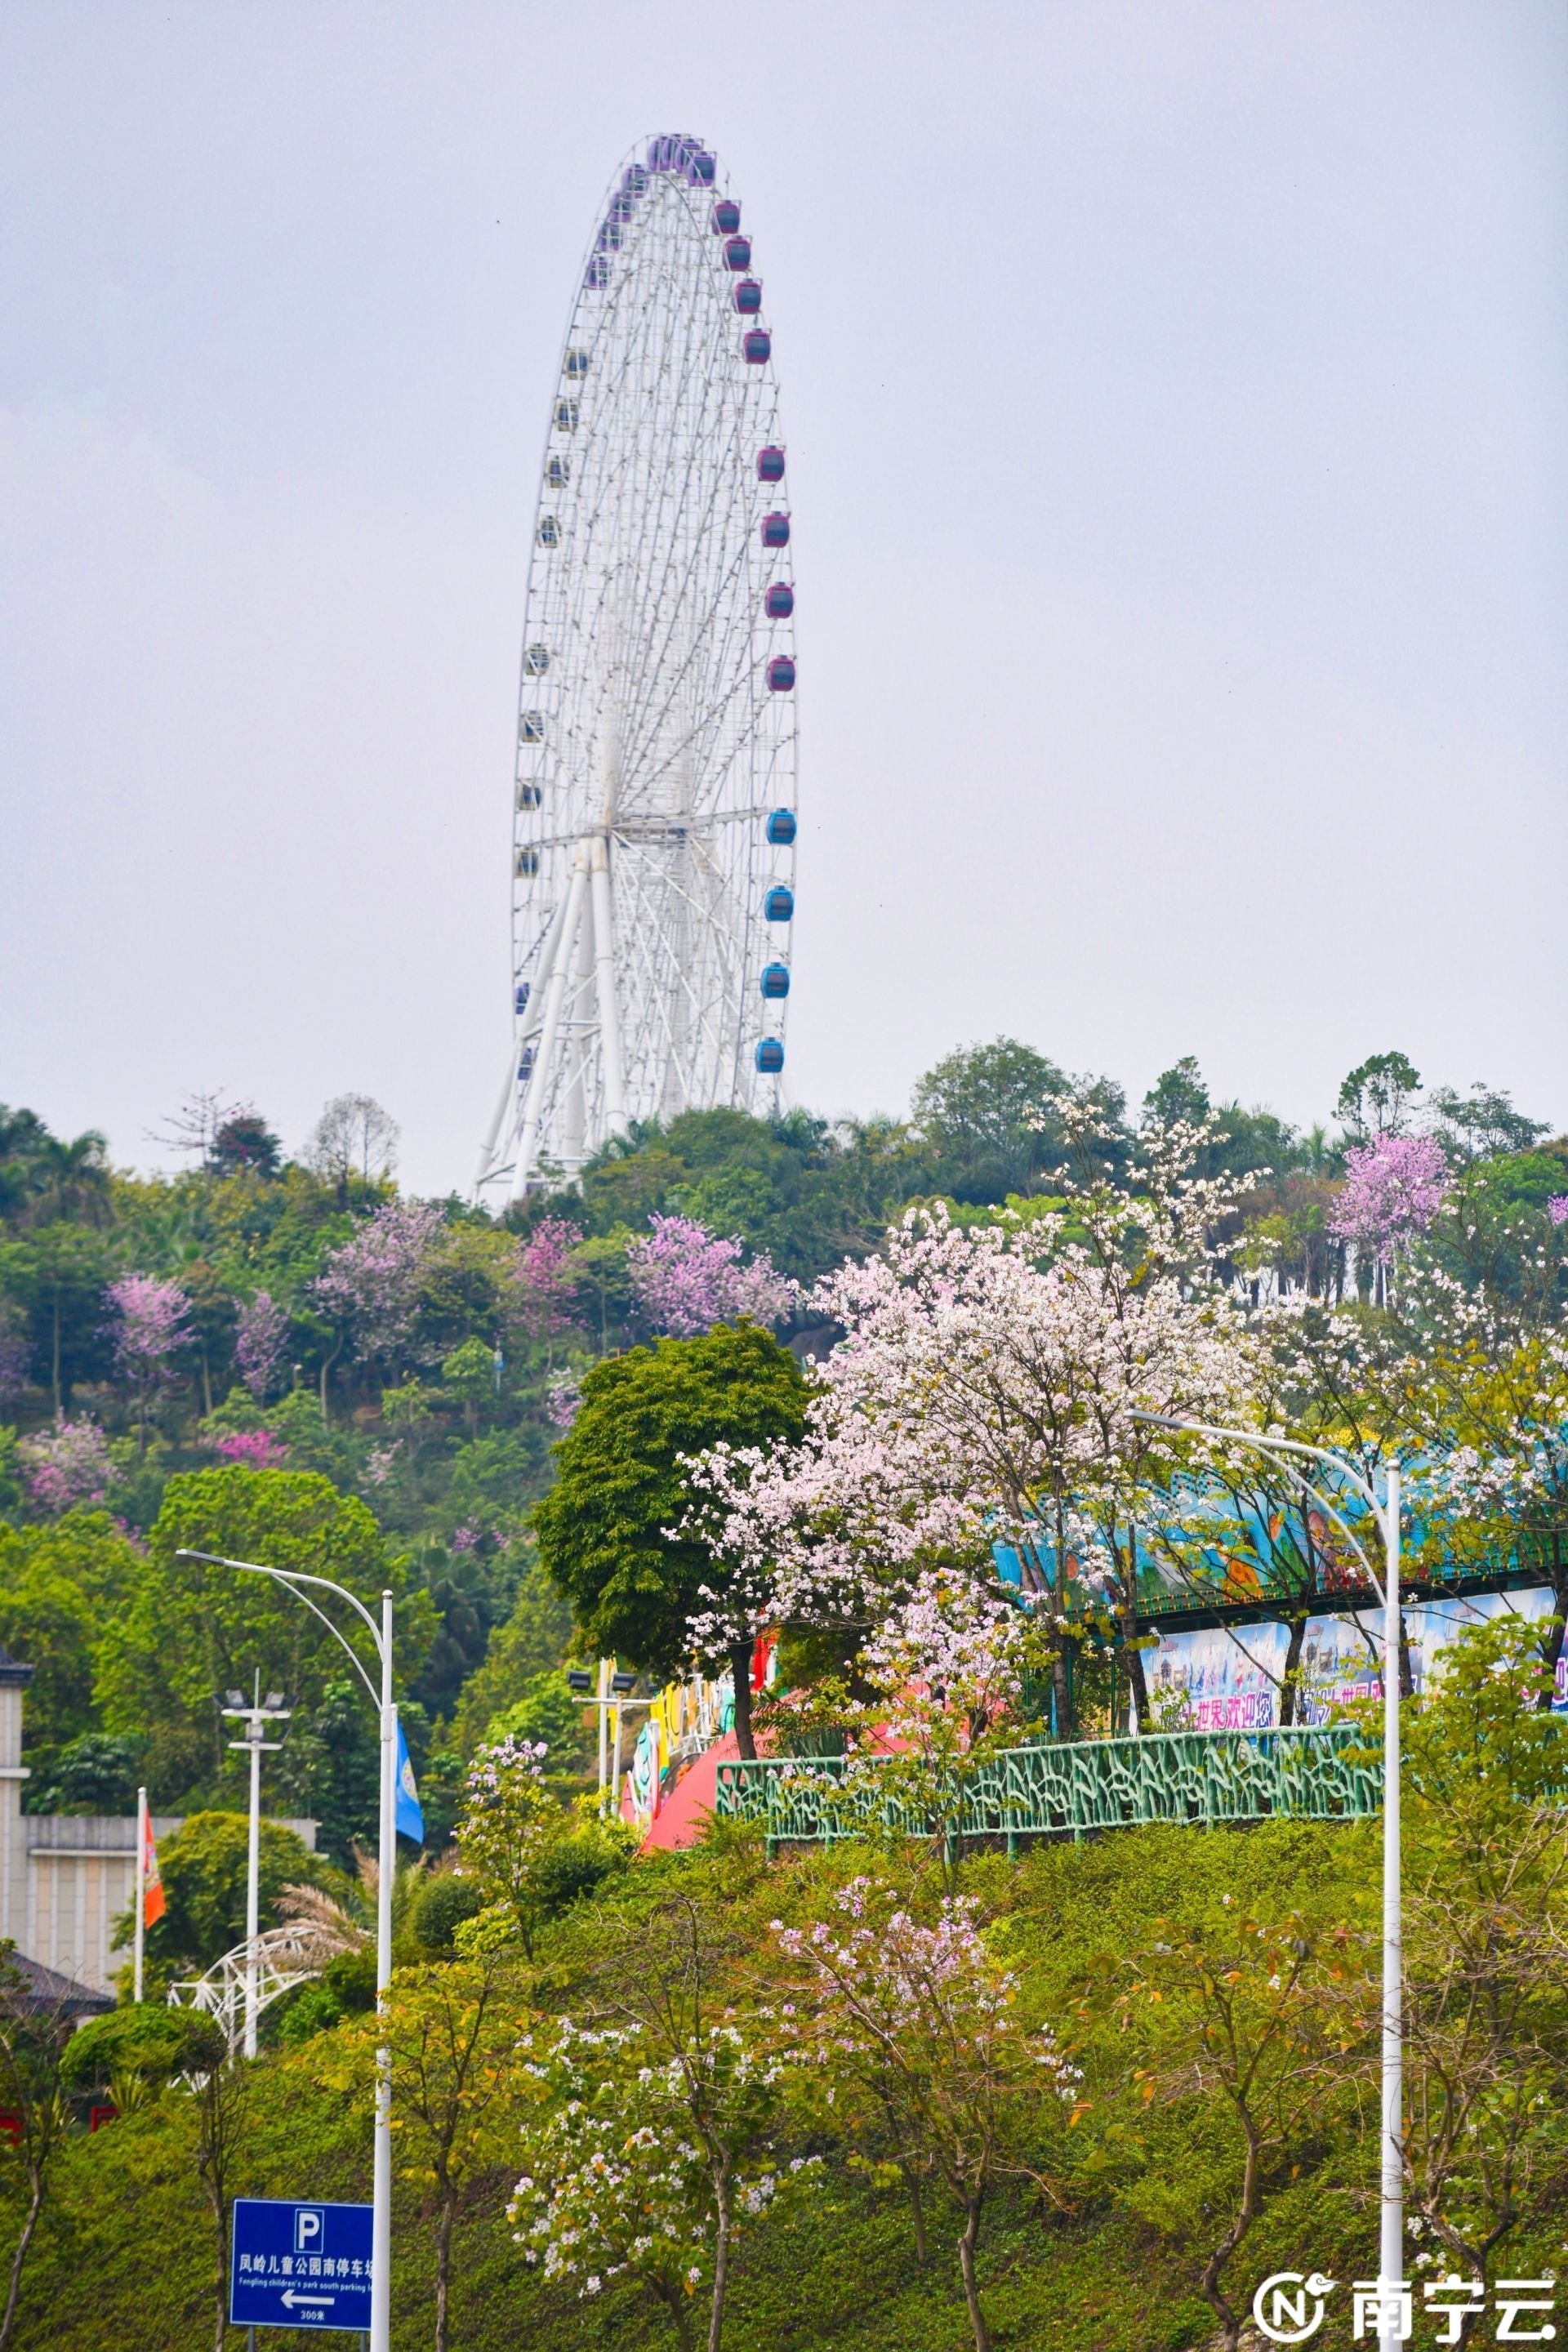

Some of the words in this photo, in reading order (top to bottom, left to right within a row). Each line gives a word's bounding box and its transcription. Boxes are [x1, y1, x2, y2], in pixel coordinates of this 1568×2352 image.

[298, 2212, 320, 2249] P
[268, 2278, 301, 2288] children's
[303, 2280, 318, 2290] park
[319, 2281, 340, 2291] south
[340, 2283, 366, 2294] parking
[300, 2310, 325, 2322] 300米
